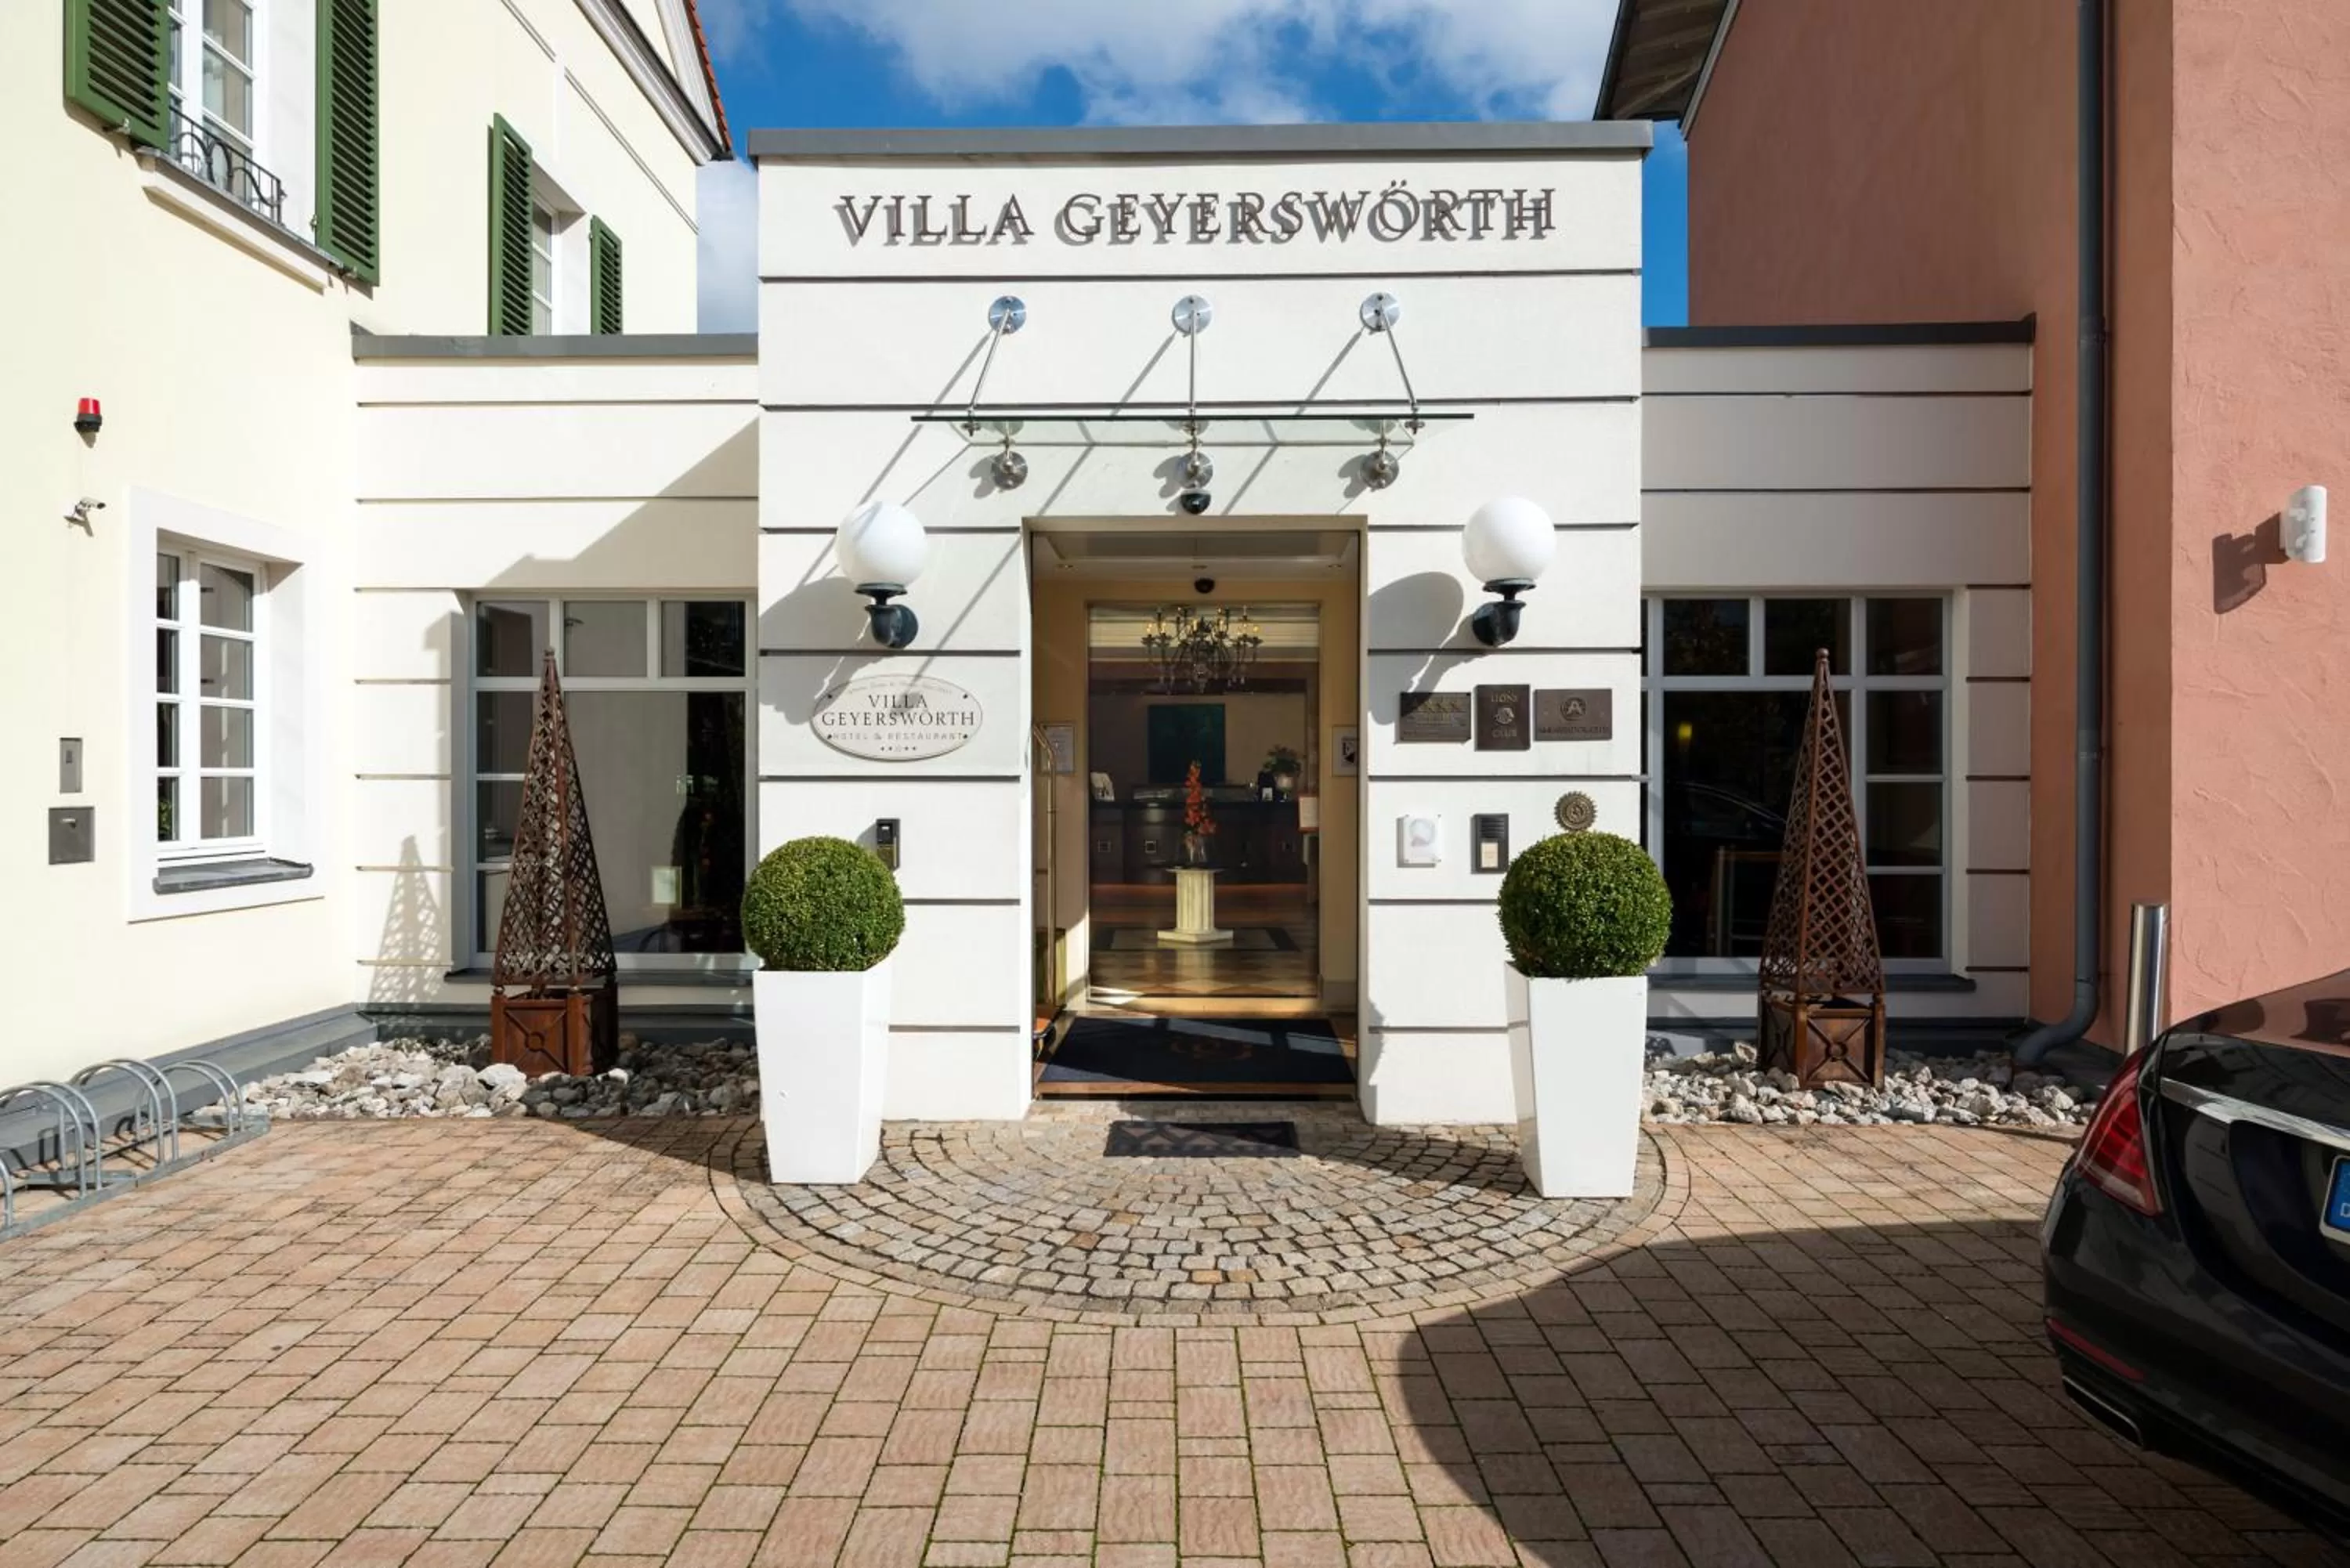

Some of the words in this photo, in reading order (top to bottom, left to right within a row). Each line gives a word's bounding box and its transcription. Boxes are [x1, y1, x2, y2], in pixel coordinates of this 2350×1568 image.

[840, 193, 1035, 237] VILLA
[1061, 180, 1556, 236] GEYERSWÖRTH
[868, 694, 928, 709] VILLA
